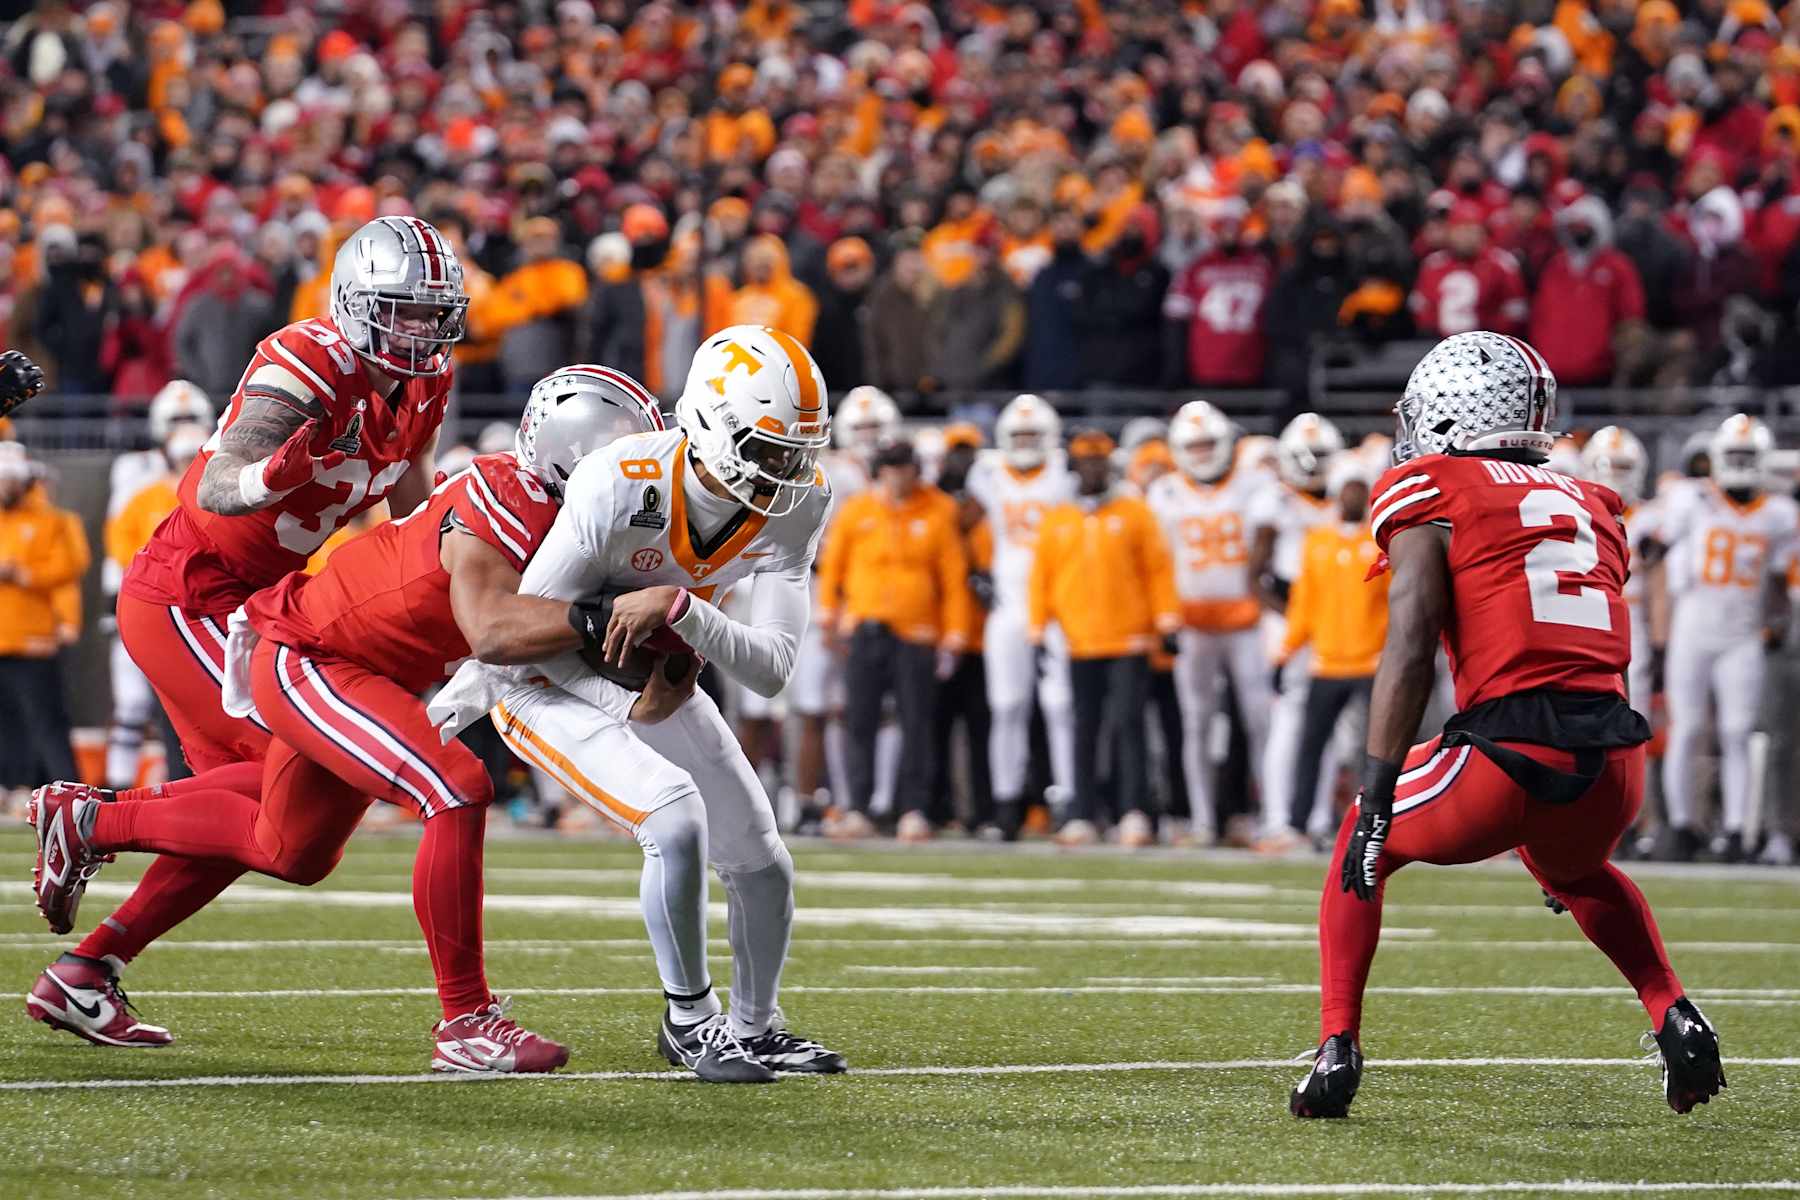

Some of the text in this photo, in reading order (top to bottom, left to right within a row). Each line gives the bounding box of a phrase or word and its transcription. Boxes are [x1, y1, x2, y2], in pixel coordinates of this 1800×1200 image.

[1200, 281, 1264, 332] 47
[1438, 271, 1480, 333] 2
[620, 458, 663, 480] 8
[1481, 460, 1586, 501] DOWNS
[1182, 513, 1249, 571] 98
[1518, 489, 1613, 631] 2
[692, 563, 712, 577] T
